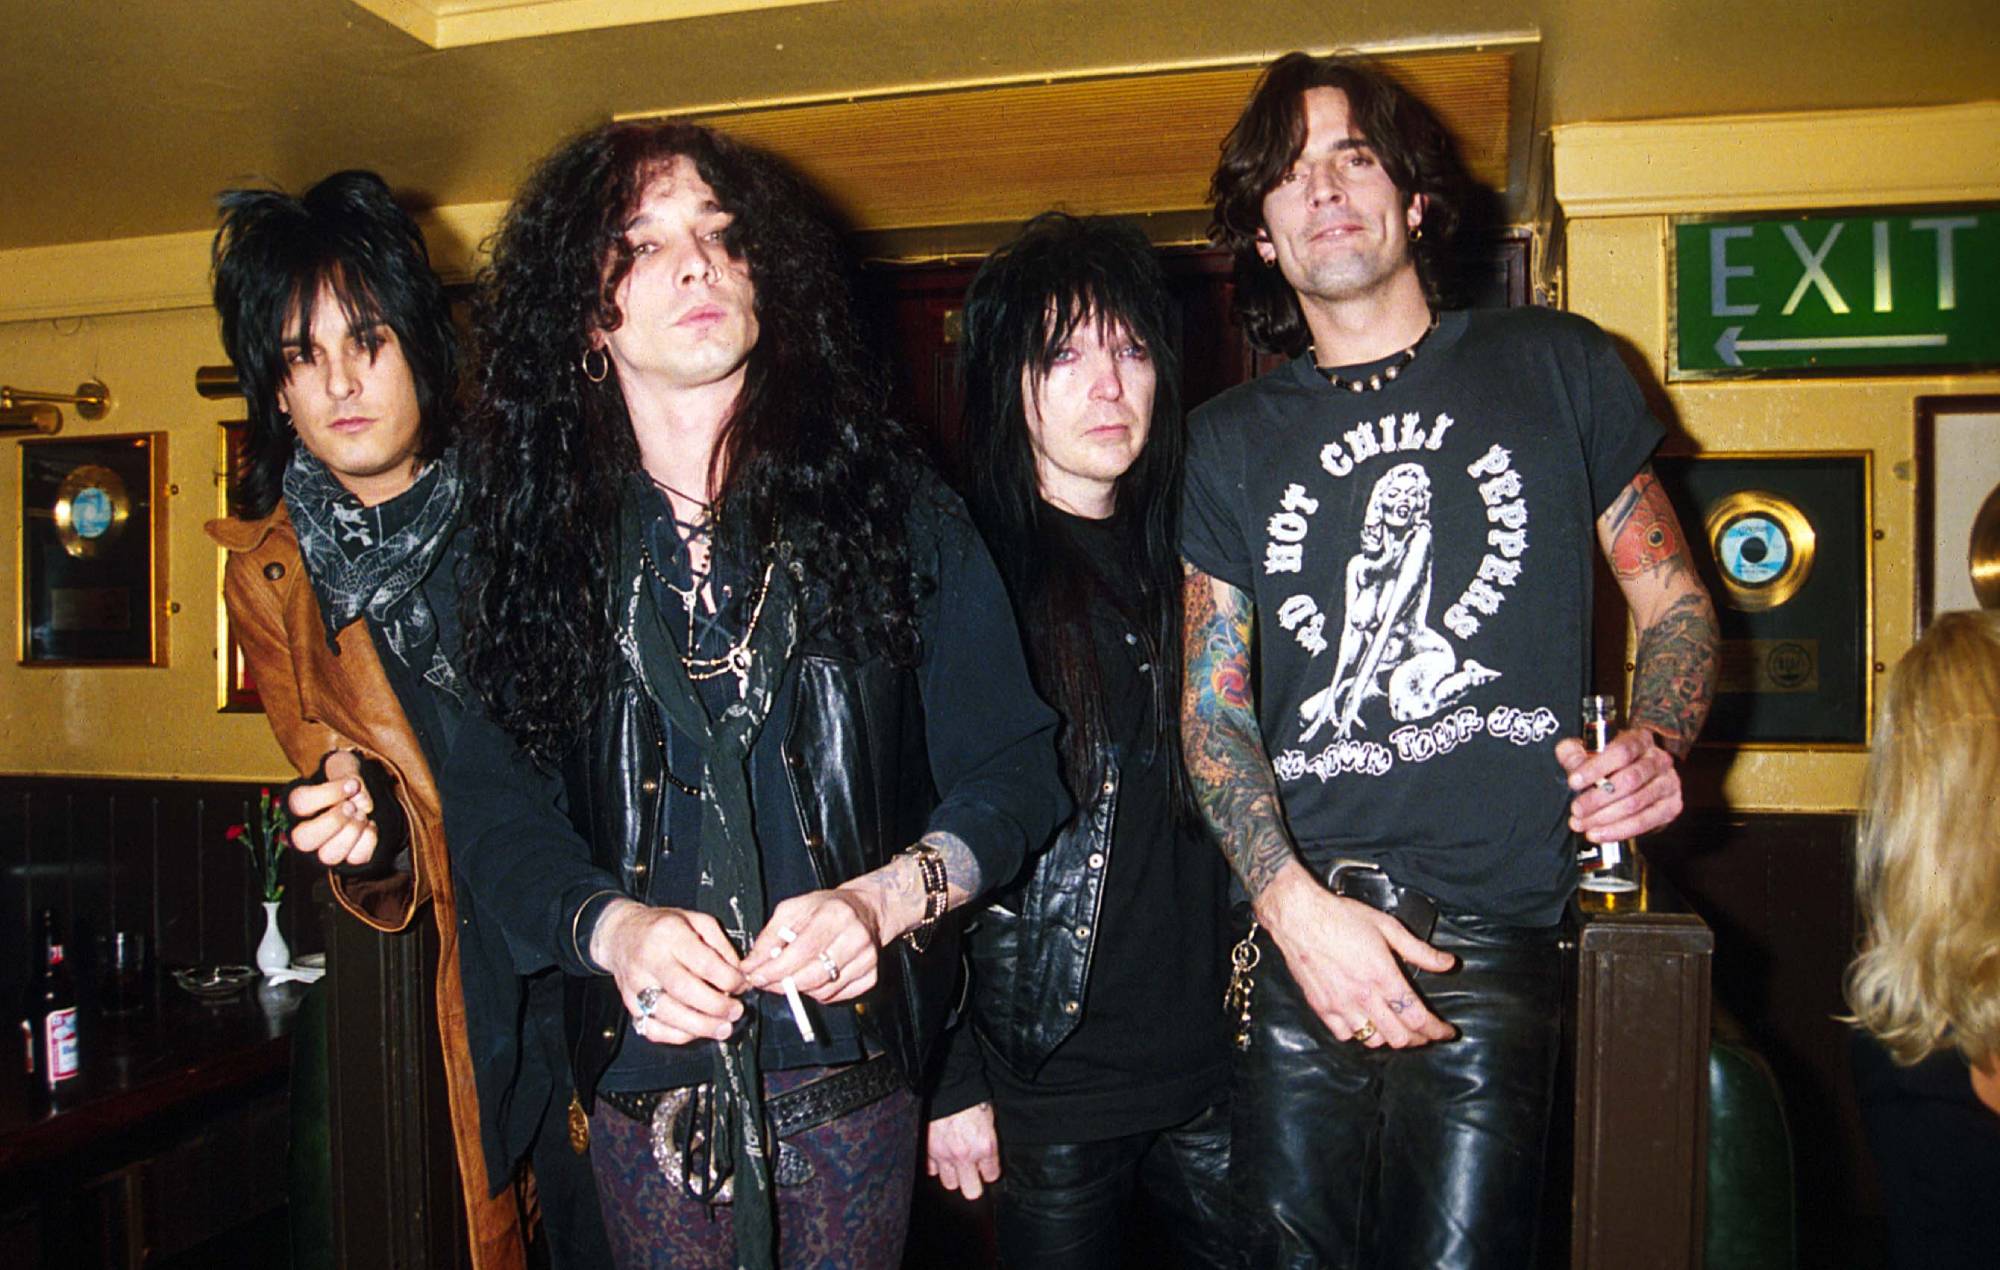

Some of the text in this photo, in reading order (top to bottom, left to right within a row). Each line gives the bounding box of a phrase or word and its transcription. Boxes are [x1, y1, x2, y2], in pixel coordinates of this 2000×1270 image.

[1709, 216, 1978, 317] EXIT
[1265, 483, 1319, 575] HOT
[1320, 412, 1454, 477] CHILI
[1443, 444, 1529, 640] PEPPERS
[1389, 706, 1484, 762] TOUR
